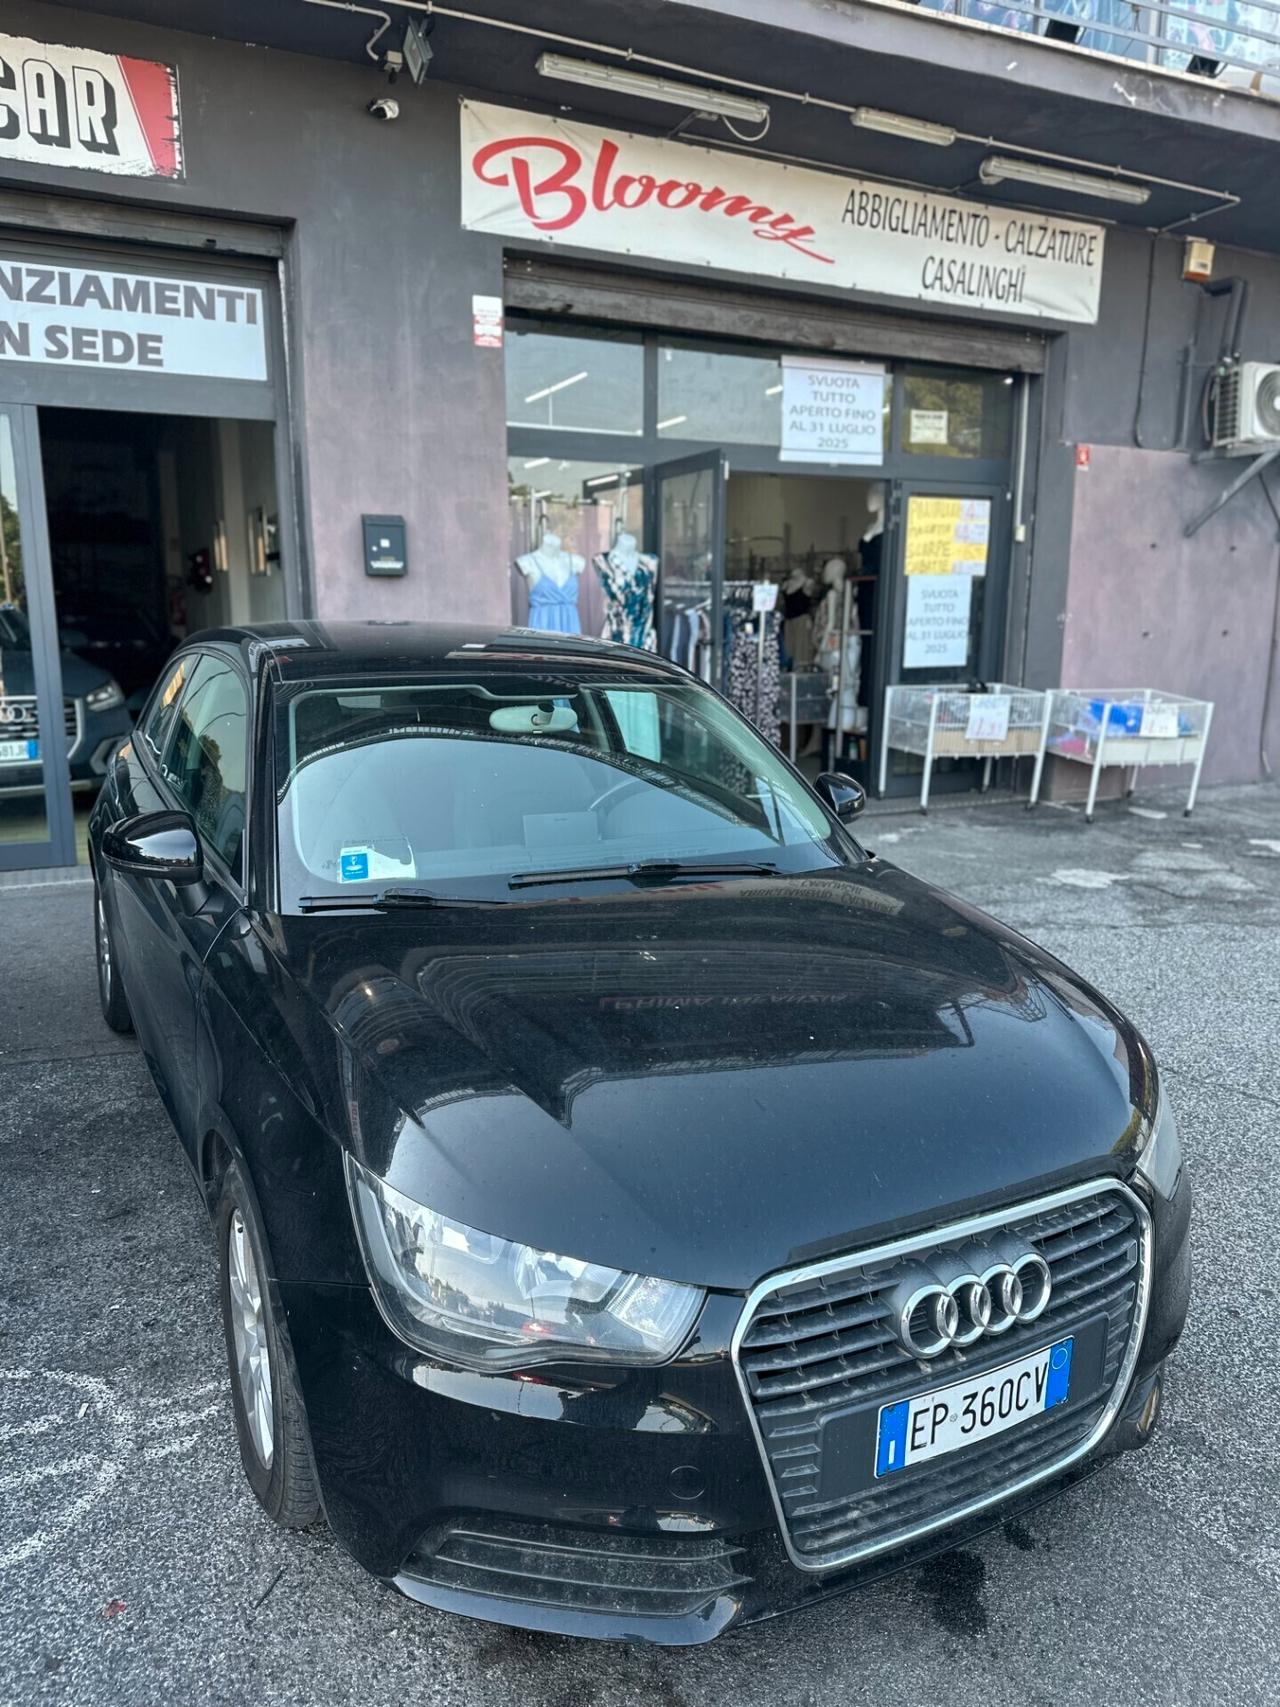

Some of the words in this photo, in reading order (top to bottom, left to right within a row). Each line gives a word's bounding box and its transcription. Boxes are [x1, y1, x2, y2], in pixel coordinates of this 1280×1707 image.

[472, 136, 835, 264] Bloomy
[841, 189, 990, 249] ABBIGLIAMENTO
[1004, 219, 1098, 267] CALZATURE
[44, 325, 165, 368] SEDE
[807, 374, 861, 389] SVUOTA
[813, 390, 857, 404] TUTTO
[789, 404, 842, 418] APERTO
[845, 408, 876, 421] FINO
[789, 420, 807, 432] AL
[809, 421, 824, 433] 31
[828, 422, 877, 436] LUGLIO
[817, 437, 849, 449] 2025
[910, 1403, 950, 1451] EP
[960, 1361, 1049, 1434] 360CV
